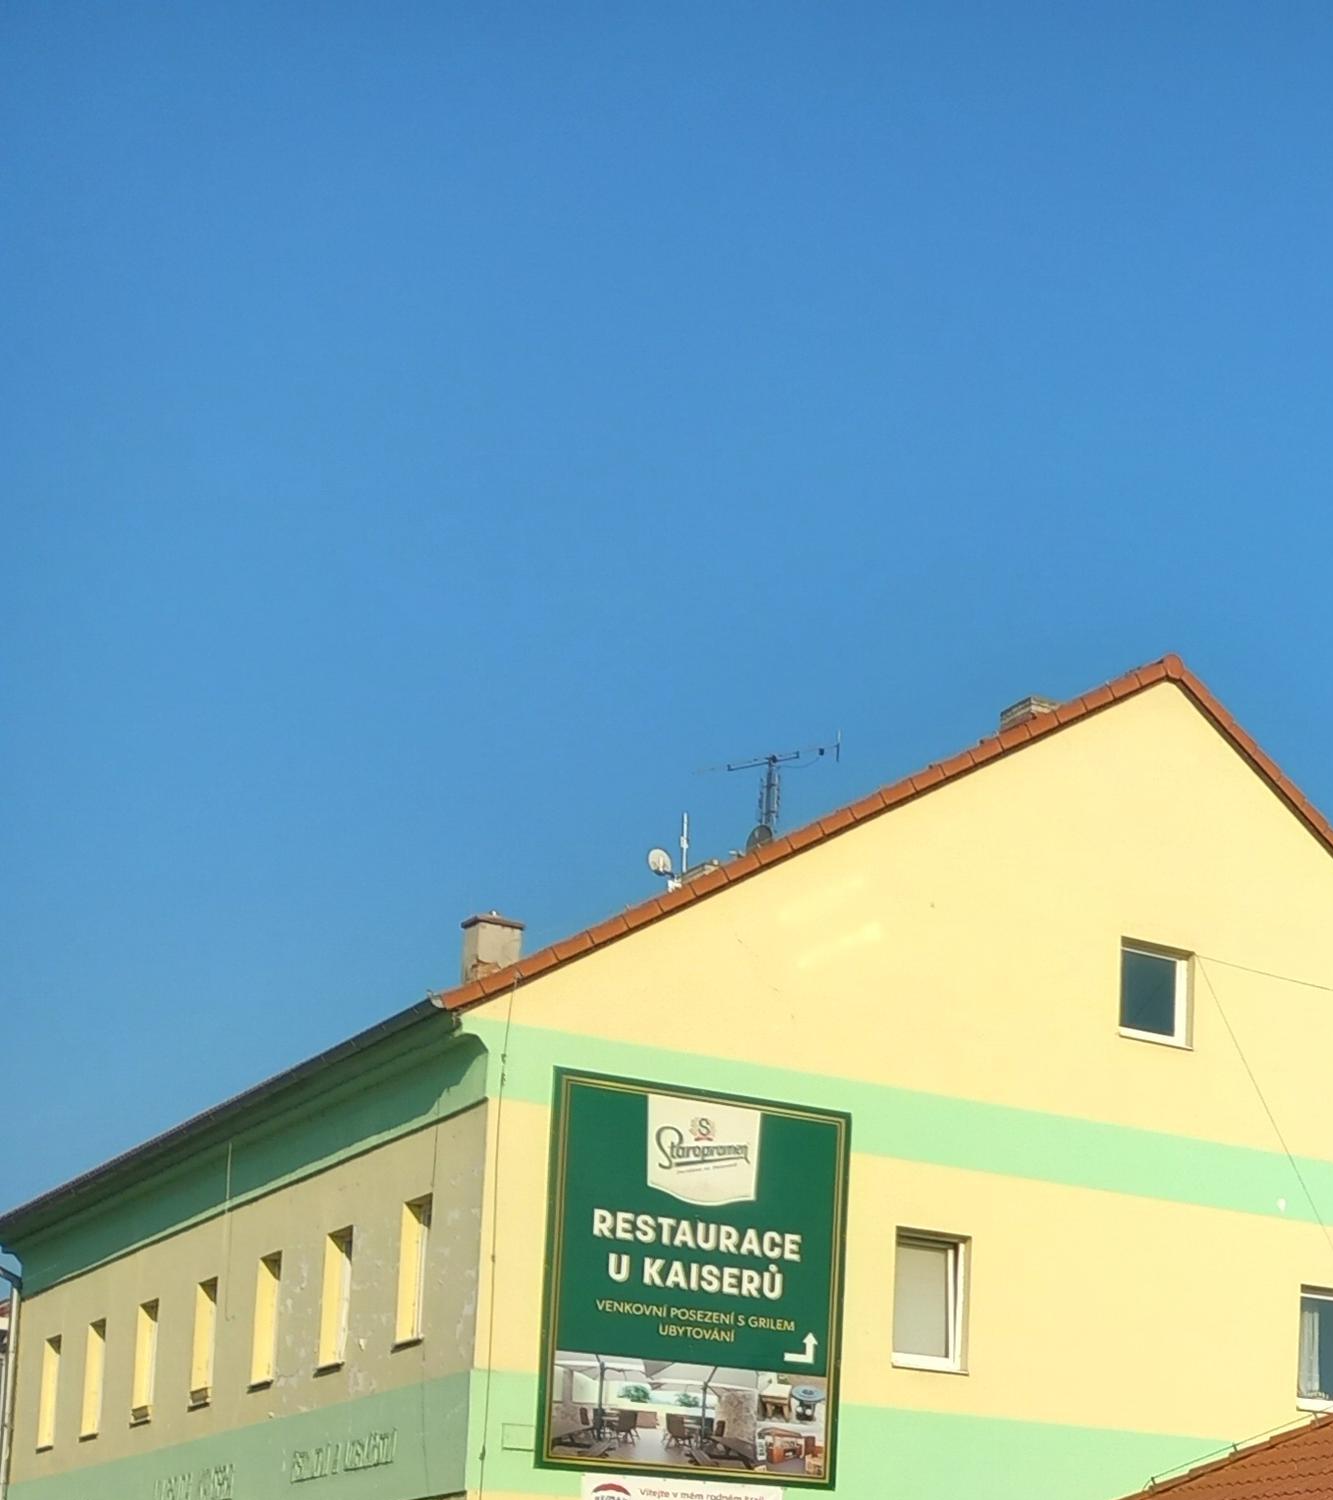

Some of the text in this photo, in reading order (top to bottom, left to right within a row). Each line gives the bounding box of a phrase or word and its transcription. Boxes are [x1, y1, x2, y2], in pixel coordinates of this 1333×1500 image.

[655, 1126, 750, 1169] Staropramen
[593, 1208, 801, 1262] RESTAURACE
[608, 1252, 783, 1300] U KAISERŮ
[596, 1299, 795, 1331] VENKOVNÍ POSEZENÍ S GRILEM
[659, 1324, 734, 1342] UBYTOVÁNÍ
